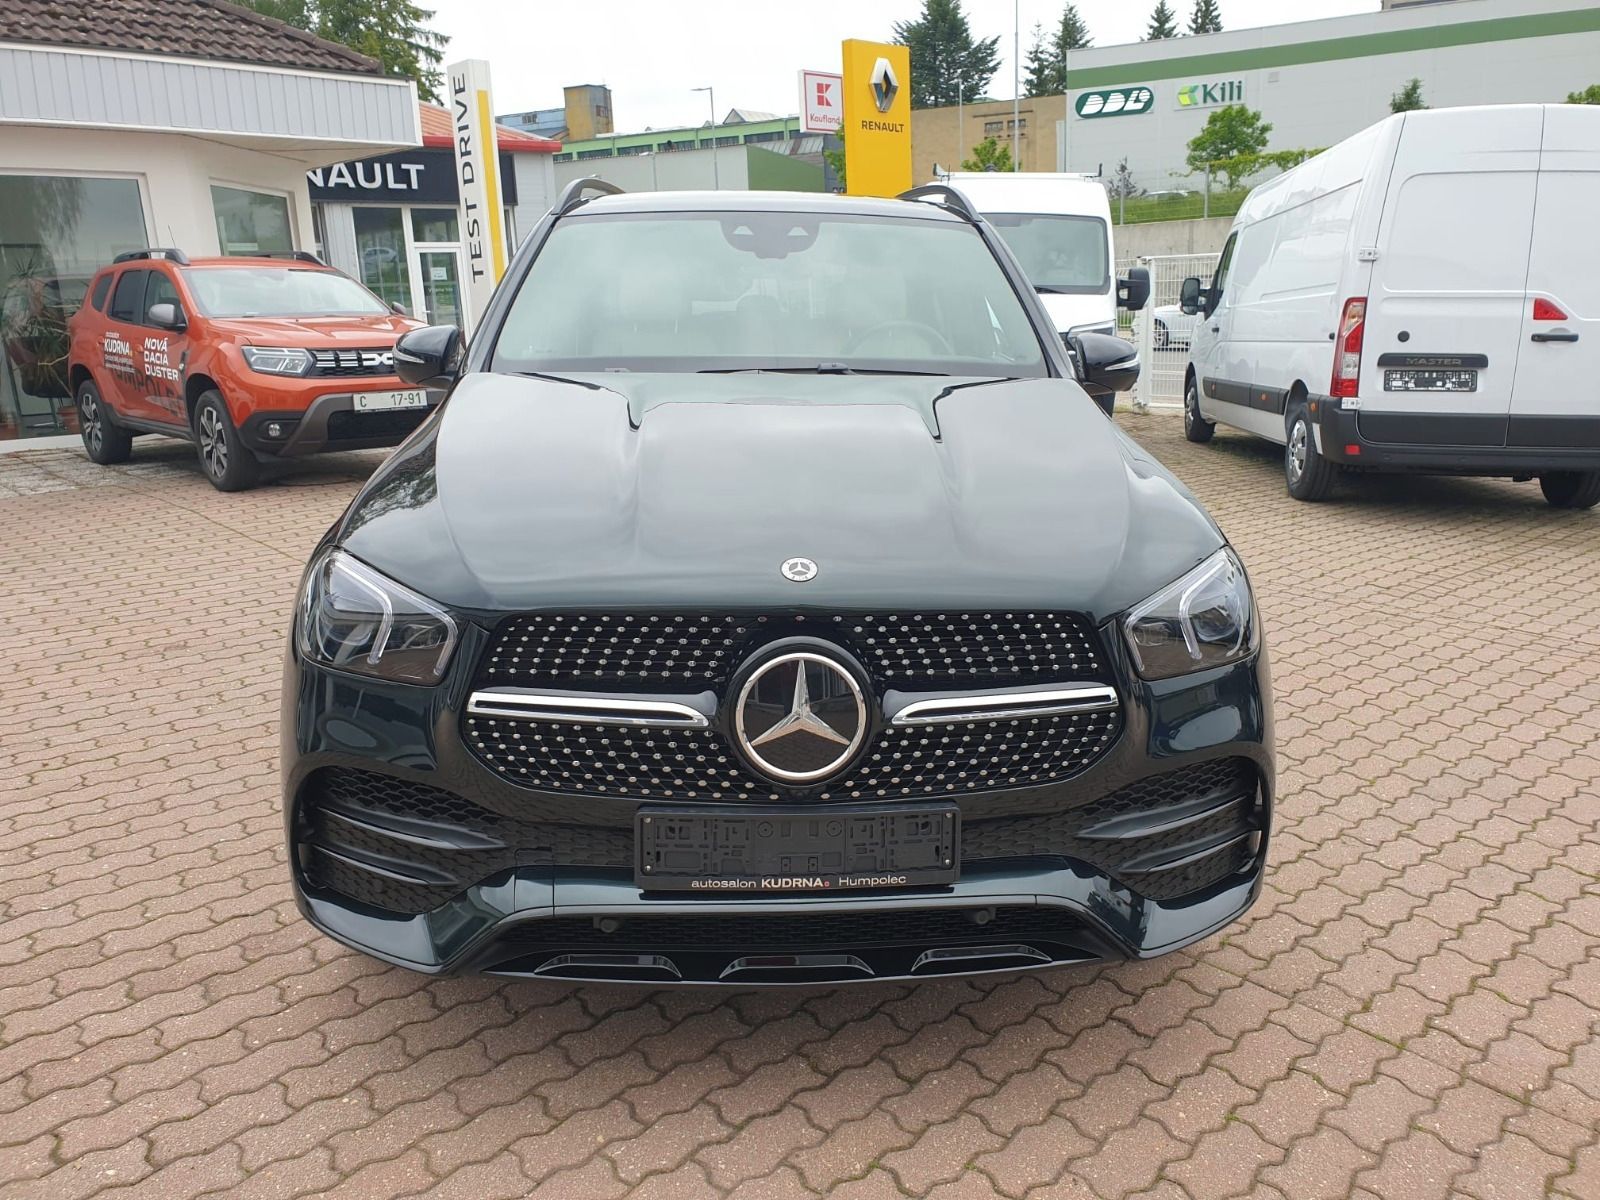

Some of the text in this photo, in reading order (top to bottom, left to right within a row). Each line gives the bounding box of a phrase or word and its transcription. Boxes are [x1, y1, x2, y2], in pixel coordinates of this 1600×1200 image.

[1202, 80, 1243, 104] Kili
[810, 113, 841, 126] Kaufland
[861, 120, 905, 133] RENAULT
[452, 72, 485, 284] TEST DRIVE
[104, 338, 130, 355] KUDRNA
[144, 337, 169, 352] NOVÁ
[143, 350, 169, 366] DACIA
[144, 364, 179, 381] DUSTER
[359, 391, 422, 408] C 17-91
[691, 874, 907, 889] autosalon KUDRNA Humpolec
